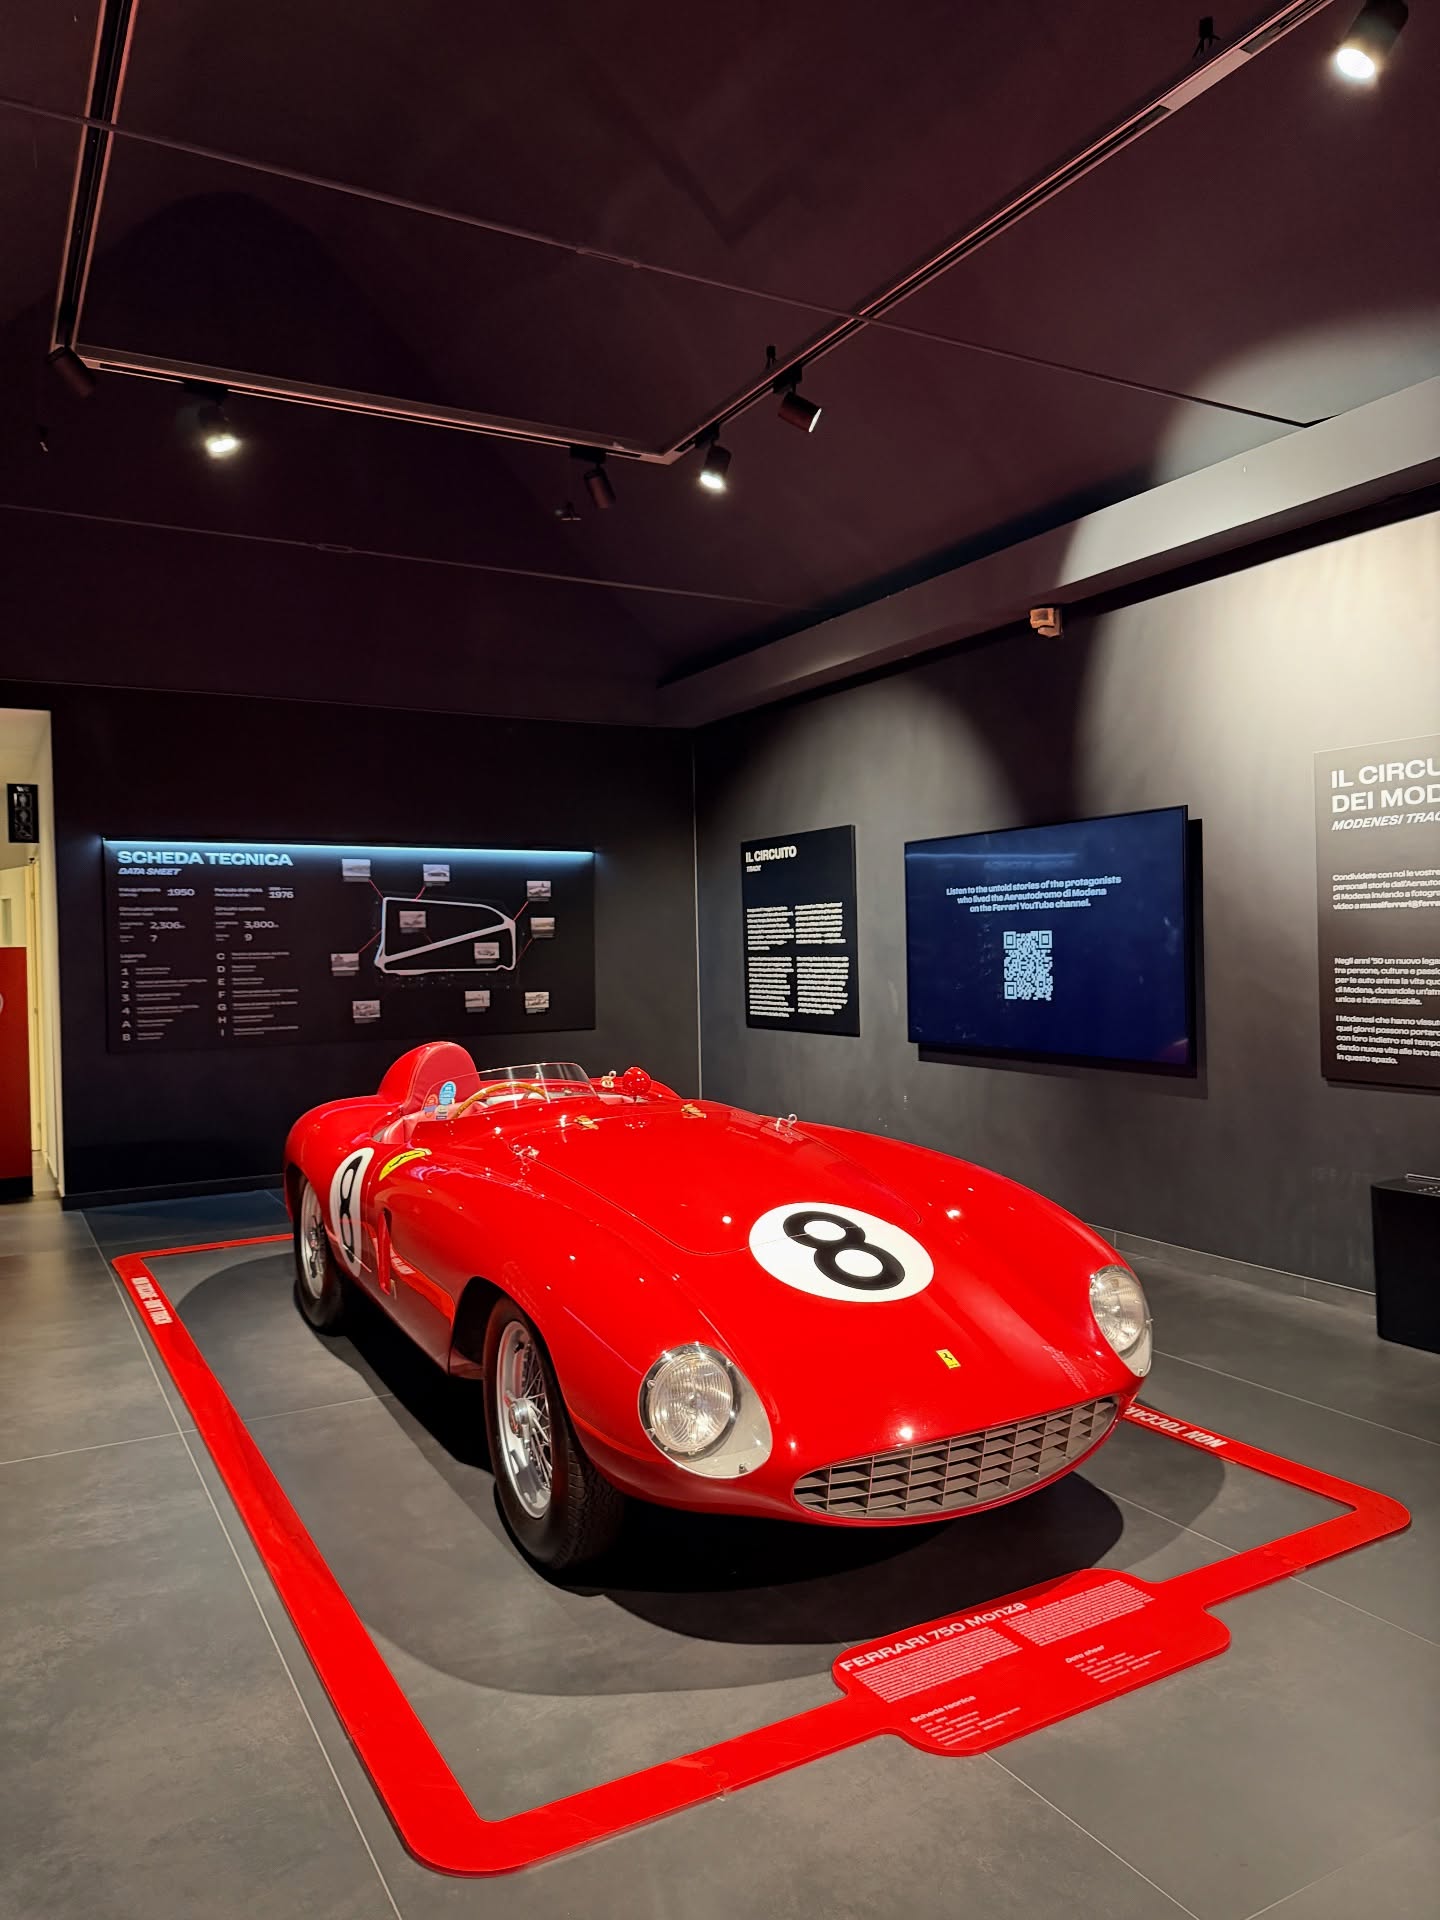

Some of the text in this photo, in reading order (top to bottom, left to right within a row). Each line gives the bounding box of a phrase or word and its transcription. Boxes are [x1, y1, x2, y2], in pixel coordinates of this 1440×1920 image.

[1331, 769, 1354, 788] IL
[1332, 783, 1440, 813] DEI MOD
[1331, 814, 1404, 830] MODENESI
[117, 851, 294, 866] SCHEDA TECNICA
[746, 846, 797, 862] IL CIRCUITO
[146, 868, 182, 876] SHEET
[946, 888, 968, 896] Listen
[968, 886, 976, 894] to
[988, 883, 1012, 892] untold
[1012, 882, 1040, 890] stories
[1040, 880, 1050, 888] of
[1050, 880, 1064, 888] the
[1065, 876, 1122, 888] protagonists
[167, 888, 195, 897] 1950
[957, 896, 972, 904] who
[973, 894, 990, 902] lived
[1004, 890, 1062, 901] Aerautodromo
[1062, 888, 1071, 897] di
[1072, 888, 1108, 896] Modena
[980, 904, 992, 912] the
[992, 902, 1019, 912] Ferrari
[1020, 900, 1054, 910] YouTube
[1055, 898, 1092, 908] channel.
[151, 934, 158, 942] 7
[244, 933, 252, 942] 9
[216, 952, 226, 960] C
[121, 968, 129, 976] 1
[216, 965, 226, 973] D
[121, 980, 129, 988] 2
[218, 978, 226, 986] E
[218, 990, 226, 998] F
[217, 1003, 228, 1011] G
[122, 1020, 132, 1028] A
[218, 1016, 227, 1024] H
[1390, 1017, 1416, 1025] hanno
[122, 1033, 131, 1041] B
[1360, 1046, 1384, 1054] nuova
[1384, 1046, 1398, 1054] vita
[1413, 1048, 1430, 1056] loro
[1344, 1054, 1370, 1062] questo
[339, 1155, 363, 1263] 8
[782, 1210, 906, 1290] 8
[1182, 1430, 1228, 1448] NON
[839, 1601, 1028, 1672] FERRARI 750 Monza
